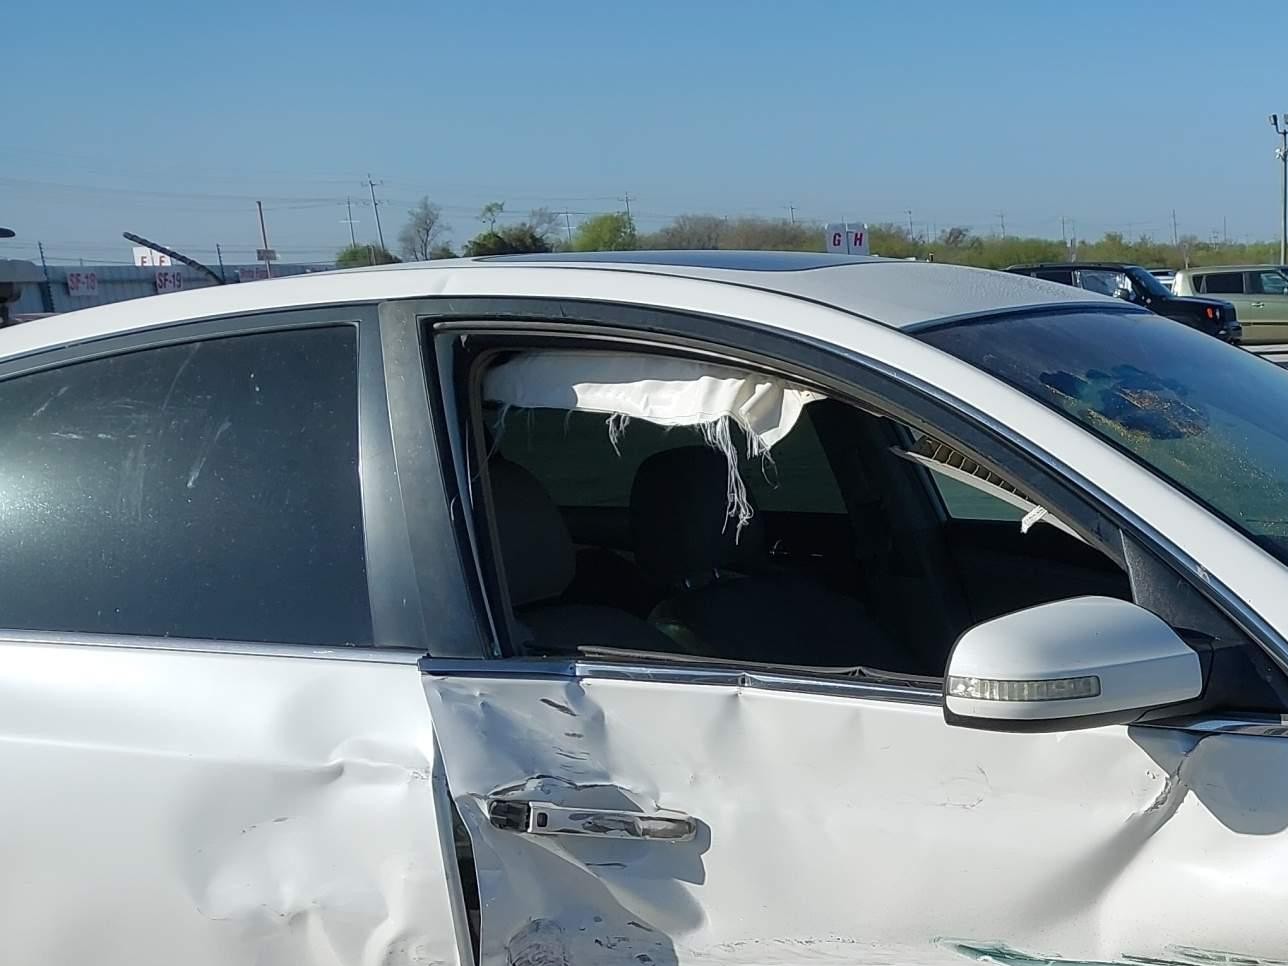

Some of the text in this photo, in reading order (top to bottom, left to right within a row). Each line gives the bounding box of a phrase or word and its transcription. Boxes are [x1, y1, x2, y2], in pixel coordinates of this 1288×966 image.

[833, 233, 863, 246] G H
[157, 272, 181, 289] SF-19
